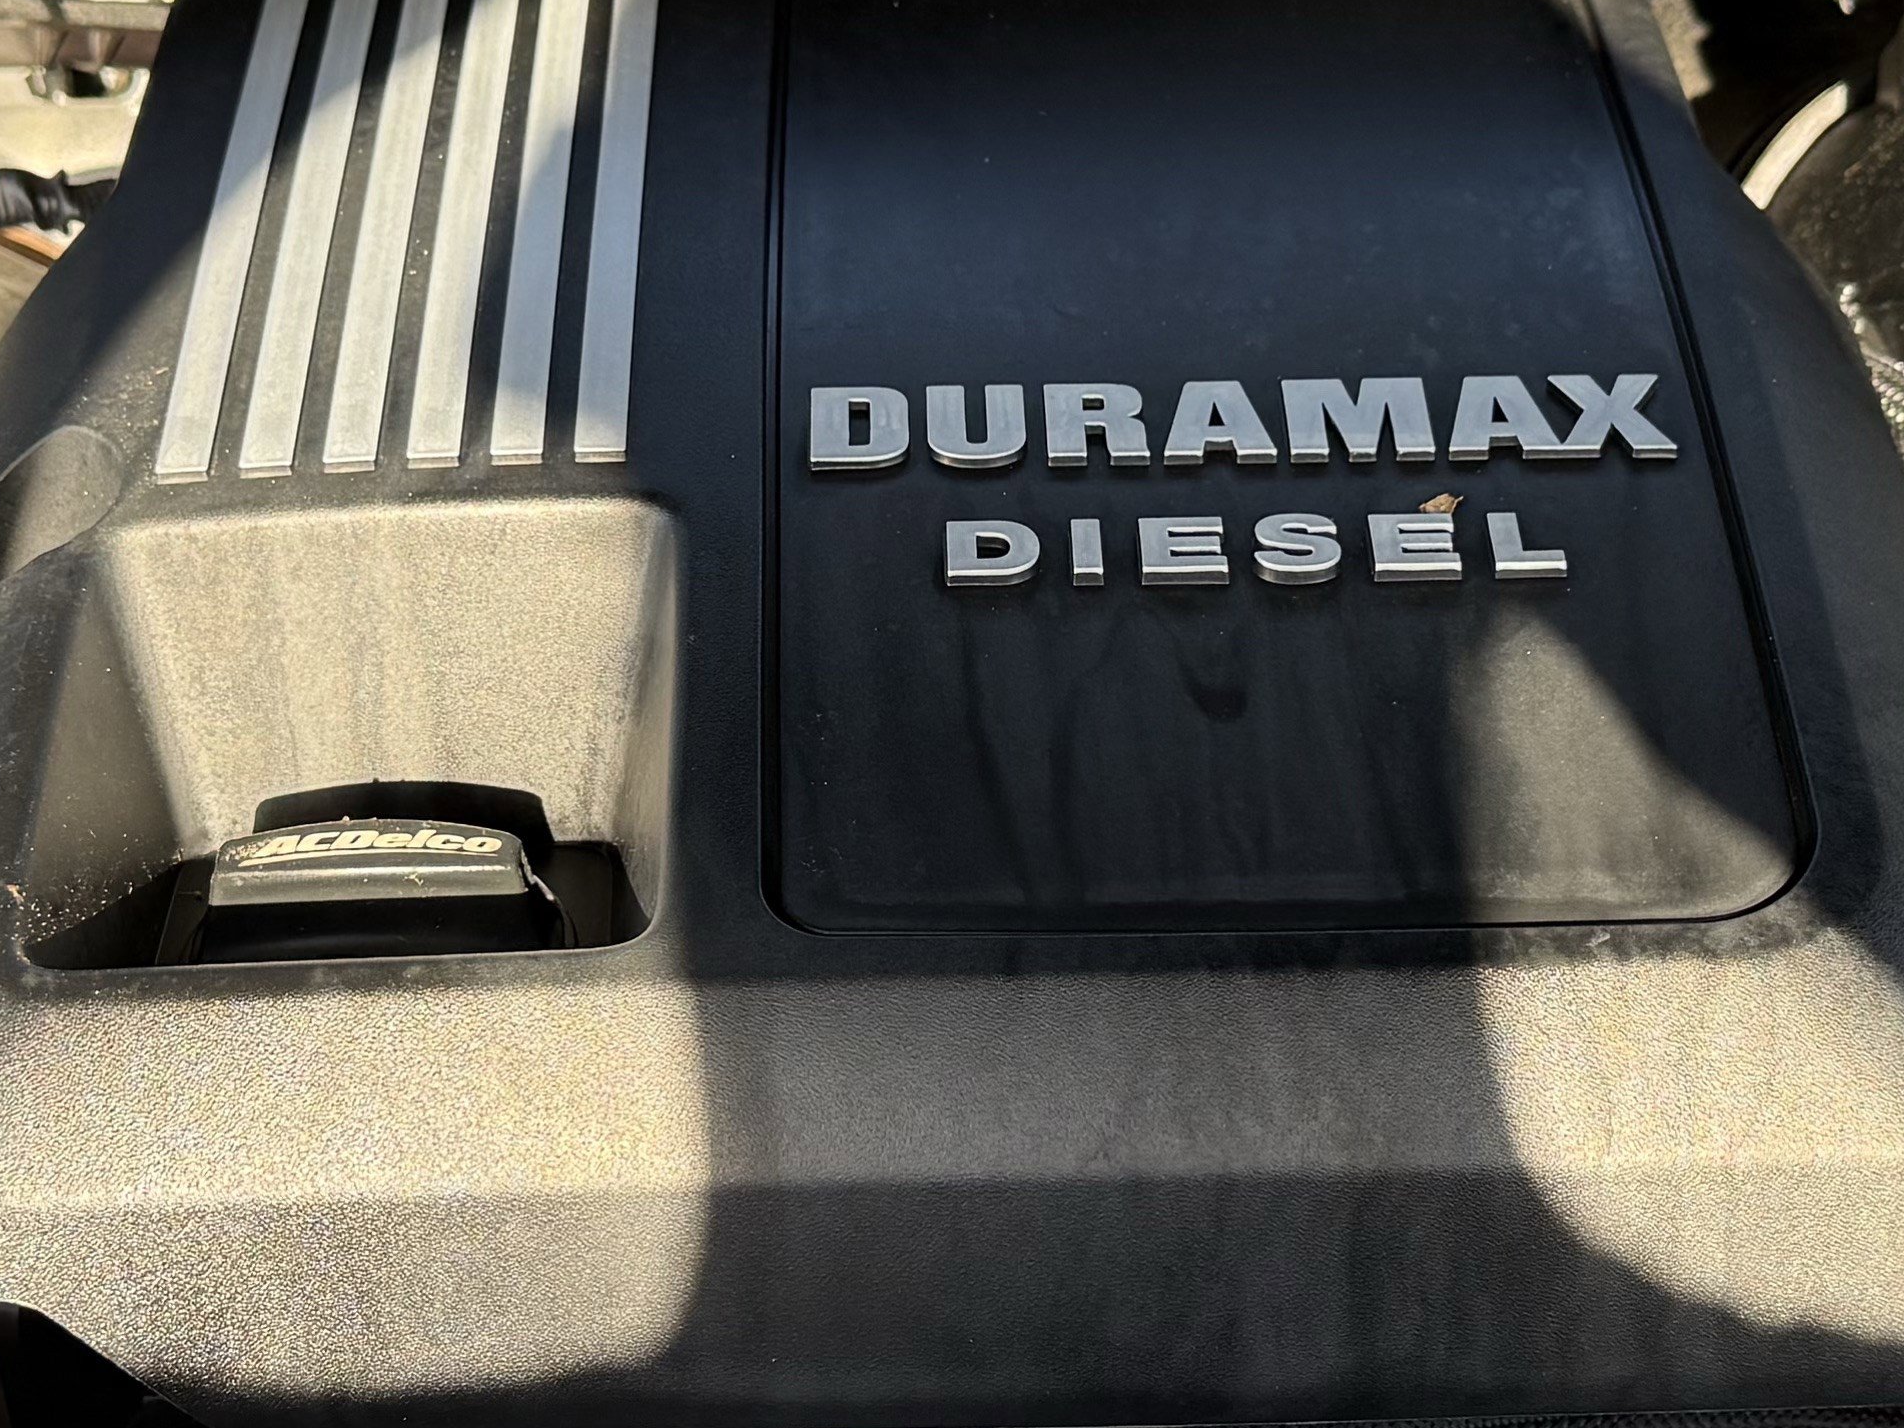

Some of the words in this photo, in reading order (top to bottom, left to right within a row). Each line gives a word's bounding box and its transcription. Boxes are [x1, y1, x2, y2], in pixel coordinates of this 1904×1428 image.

[809, 373, 1678, 470] DURAMAX
[945, 511, 1567, 585] DIESEL
[257, 828, 502, 857] ACDelco
